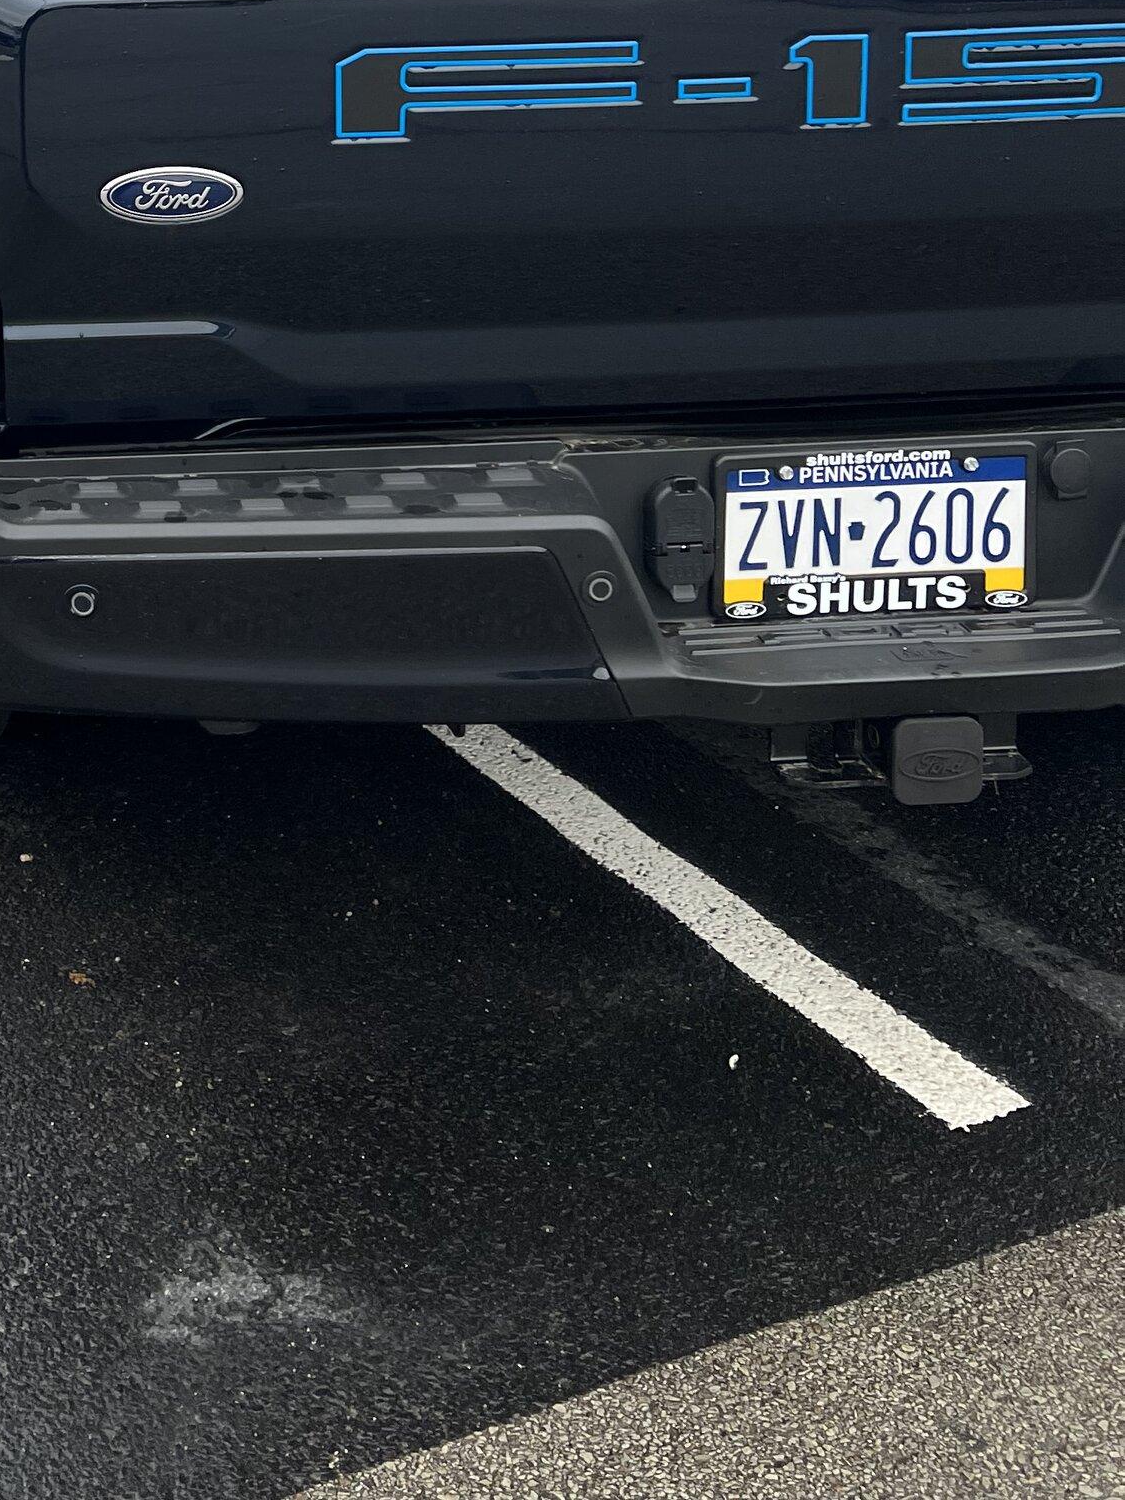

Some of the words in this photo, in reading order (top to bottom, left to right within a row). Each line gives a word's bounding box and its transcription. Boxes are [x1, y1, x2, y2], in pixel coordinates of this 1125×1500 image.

[134, 178, 211, 211] Ford
[805, 449, 951, 466] shultsford.com
[798, 461, 953, 485] PENNSYLVANIA
[786, 575, 969, 616] SHULTS
[917, 753, 963, 776] Ford
